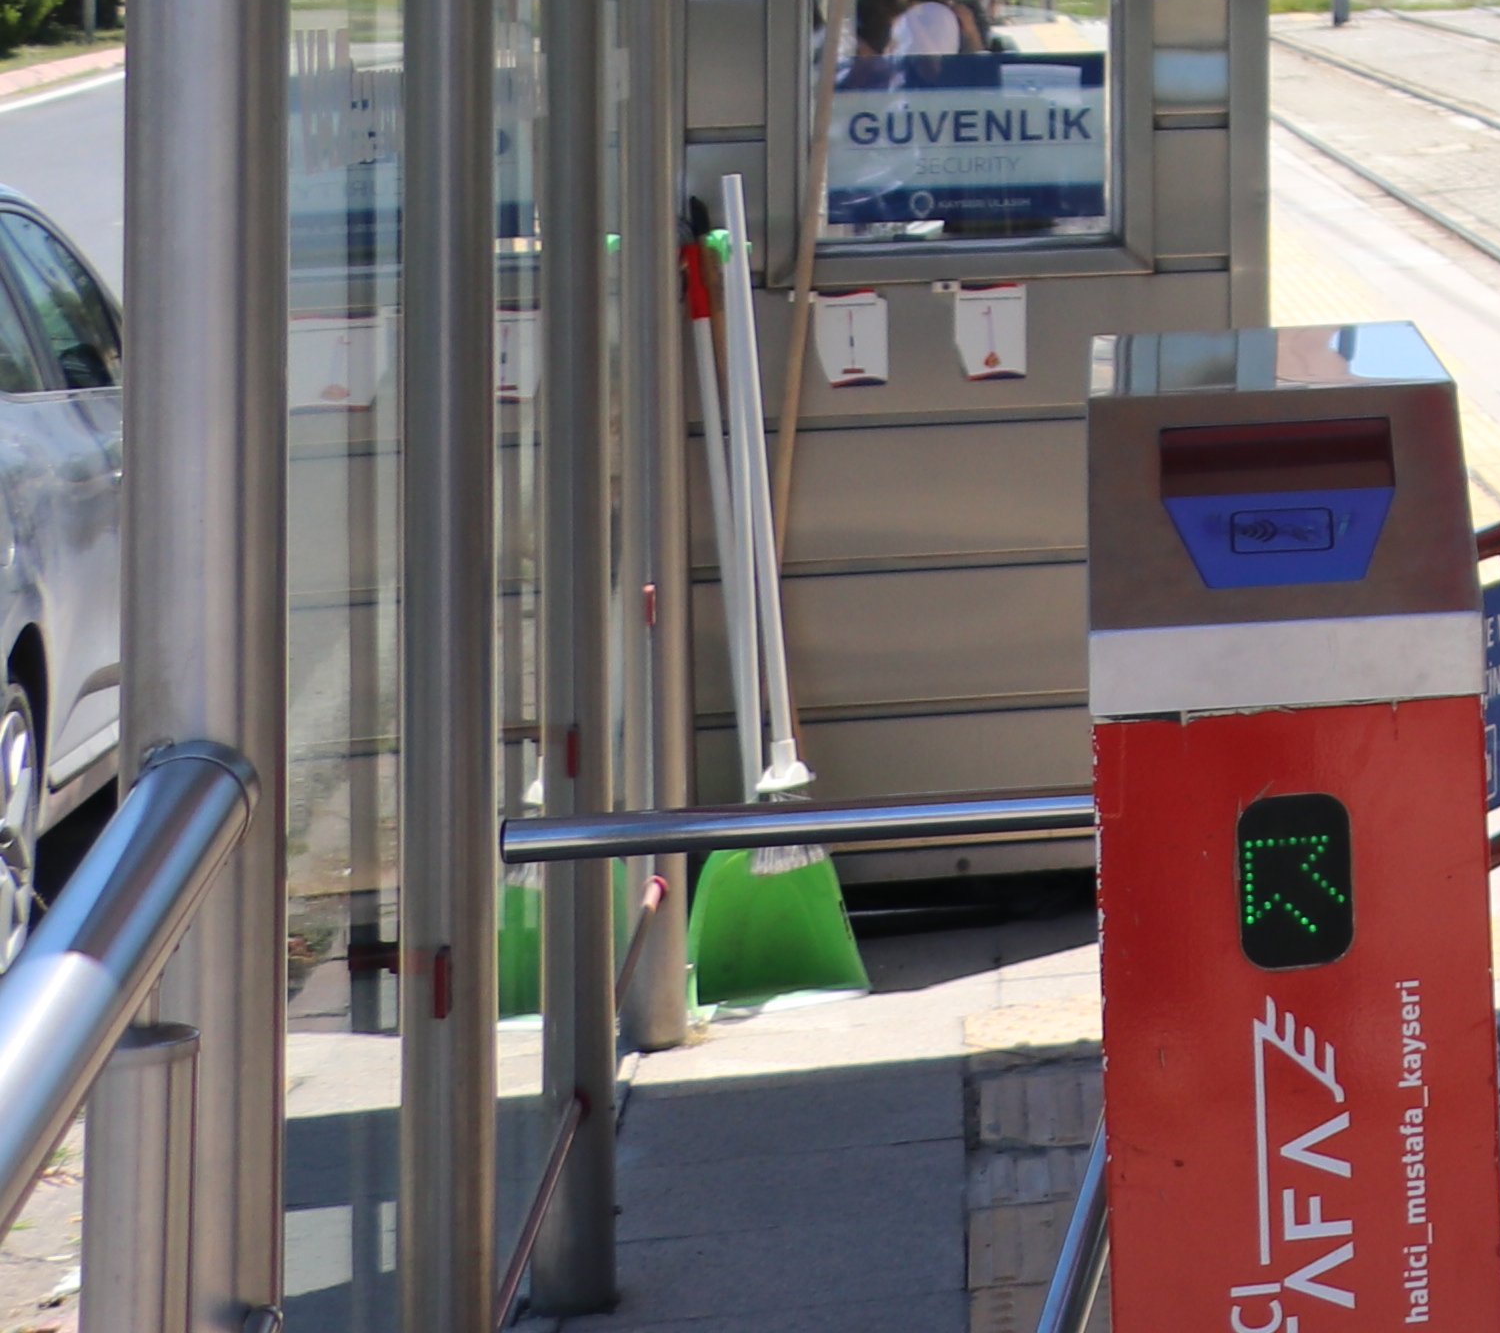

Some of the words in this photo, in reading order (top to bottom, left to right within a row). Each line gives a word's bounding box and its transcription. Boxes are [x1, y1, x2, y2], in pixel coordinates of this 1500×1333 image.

[848, 102, 1092, 145] GÜVENLİK
[916, 156, 1021, 175] SECURITY
[1395, 979, 1433, 1324] halici_mustafa_kayseri
